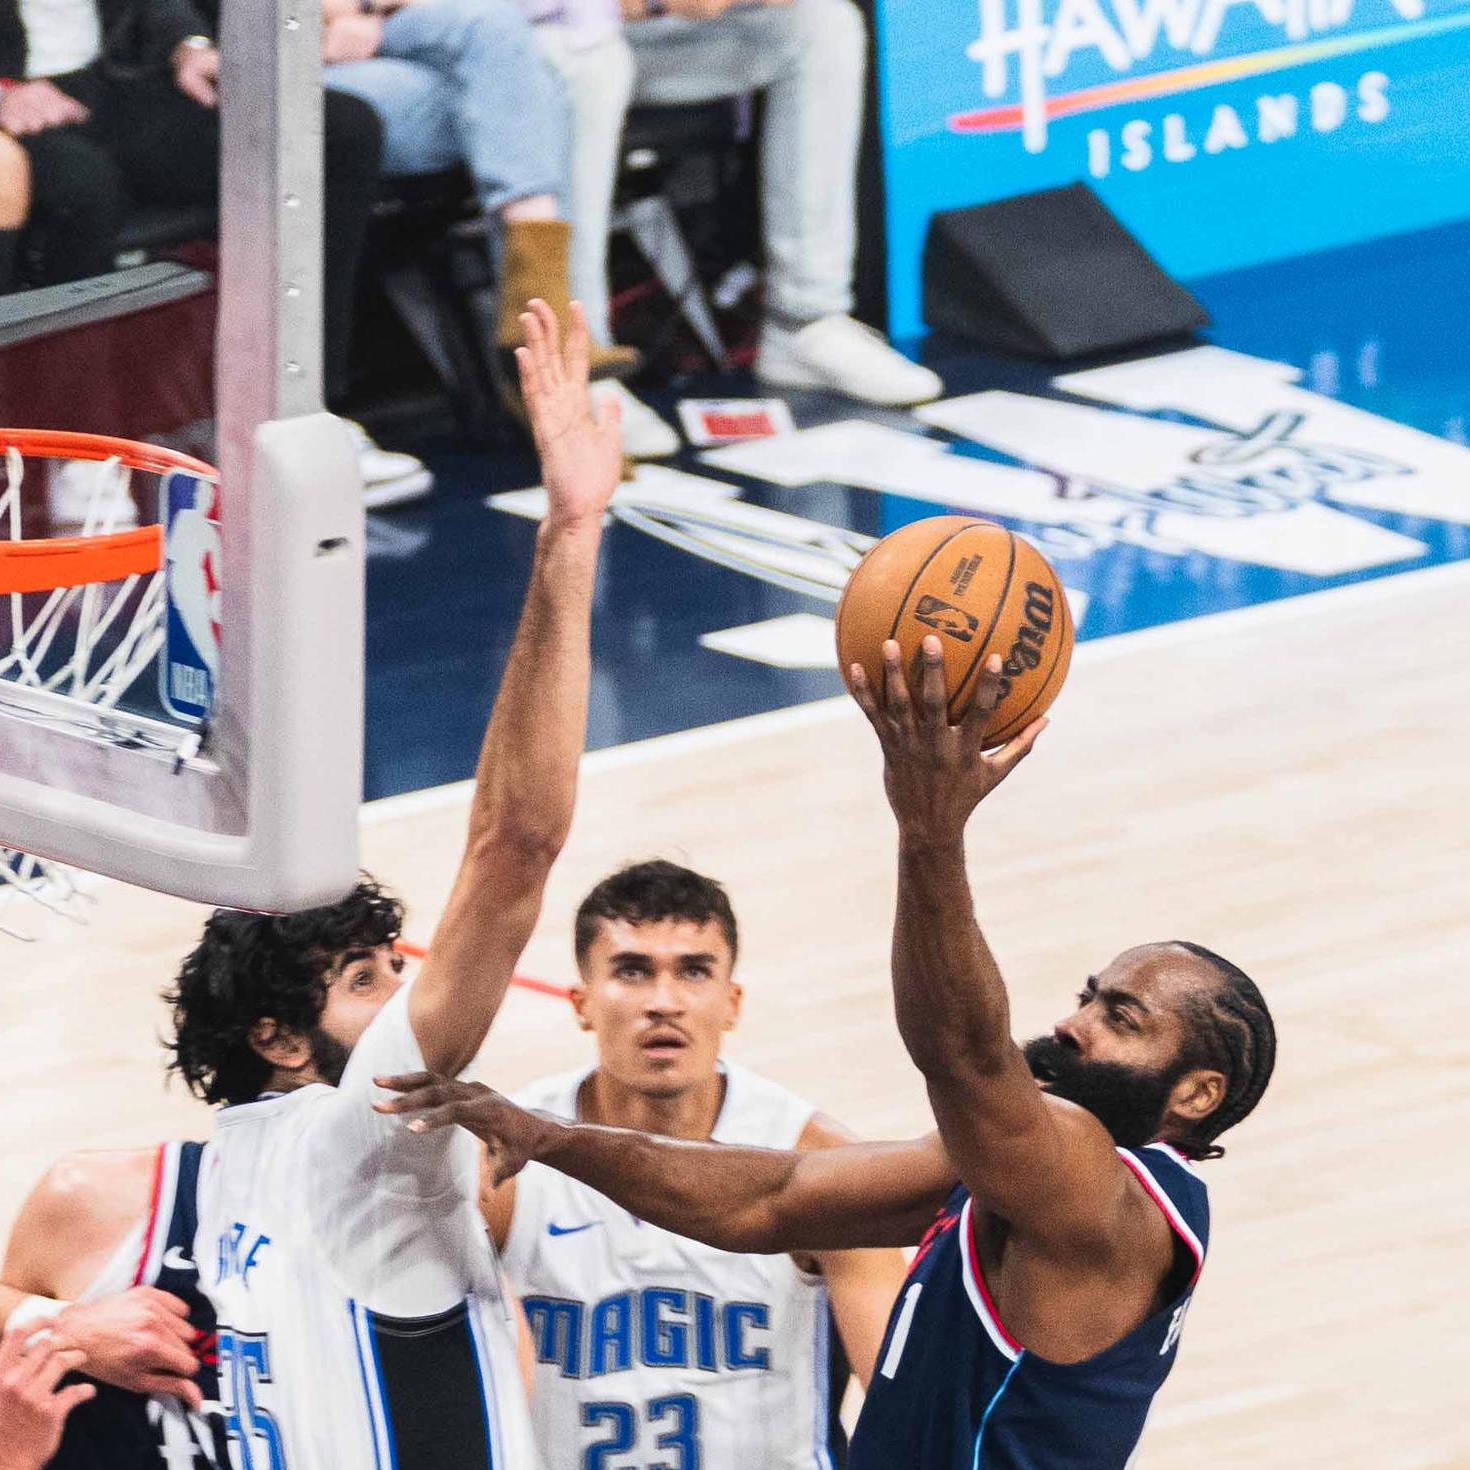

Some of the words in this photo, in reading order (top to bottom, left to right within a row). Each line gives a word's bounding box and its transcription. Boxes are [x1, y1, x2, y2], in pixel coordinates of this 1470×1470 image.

[1086, 71, 1390, 179] ISLANDS
[993, 579, 1054, 706] Wils
[521, 1285, 773, 1381] MAGIC
